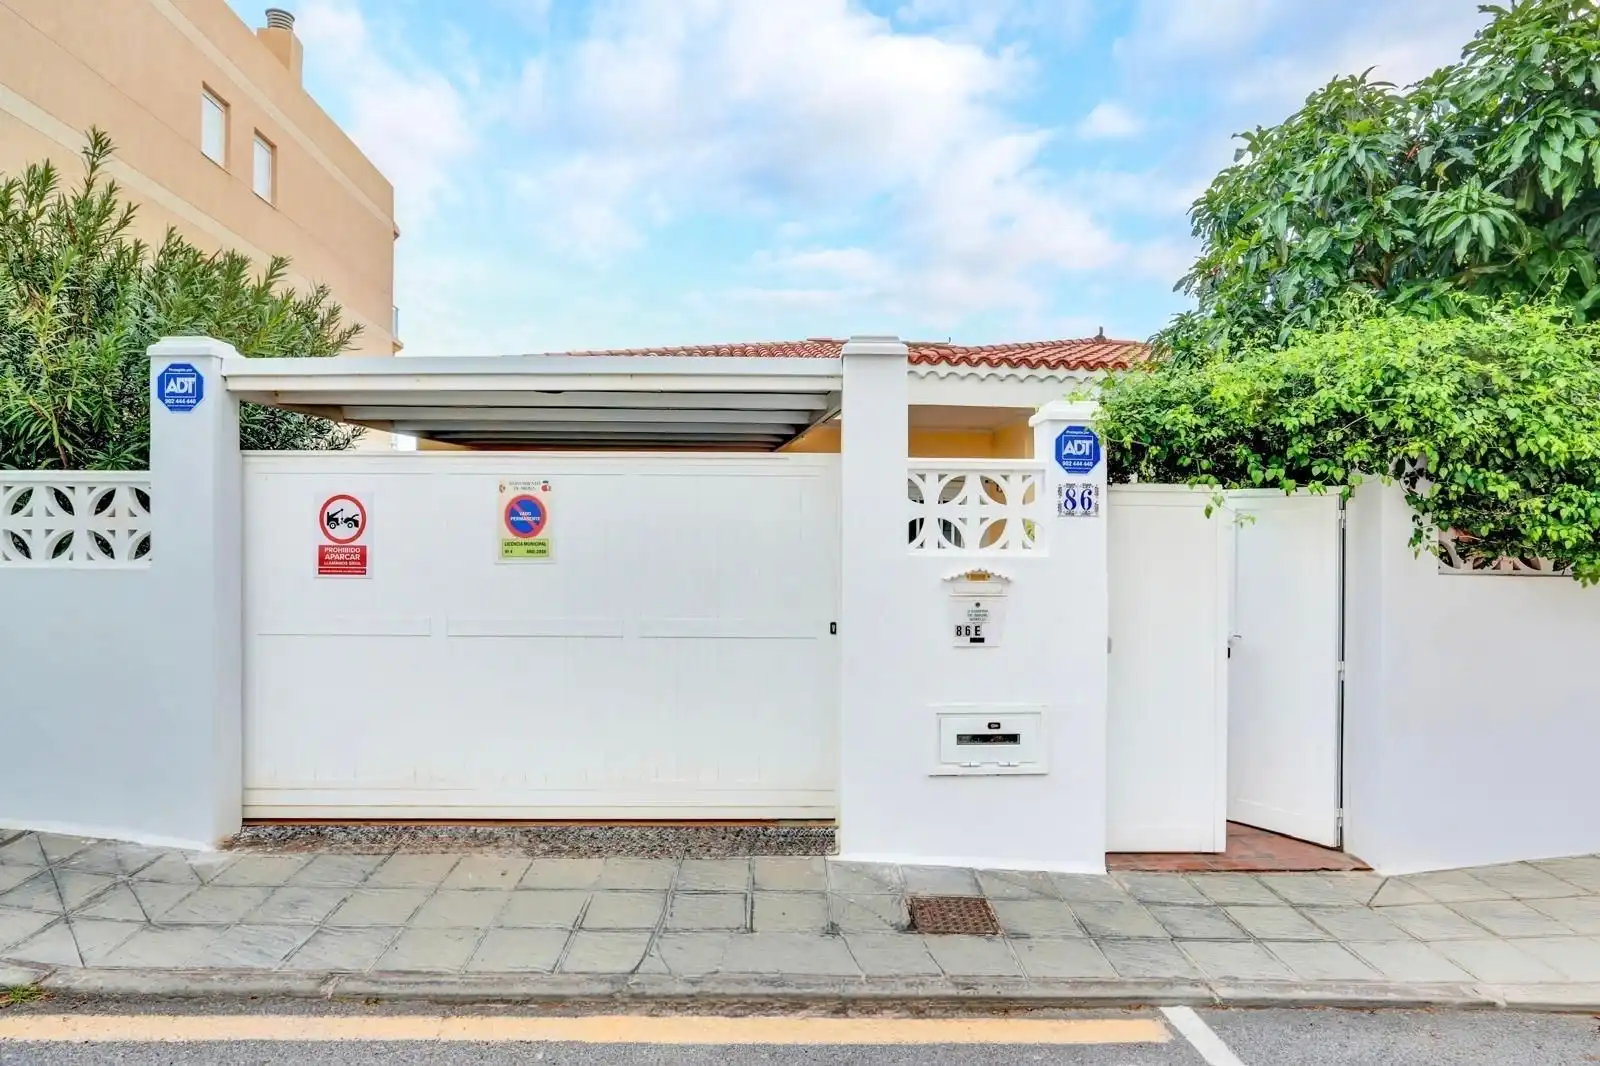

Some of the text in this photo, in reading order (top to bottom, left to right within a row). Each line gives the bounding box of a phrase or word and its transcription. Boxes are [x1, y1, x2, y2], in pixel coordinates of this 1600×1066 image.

[165, 377, 196, 394] ADT
[1063, 439, 1093, 456] ADT
[1063, 488, 1092, 511] 86
